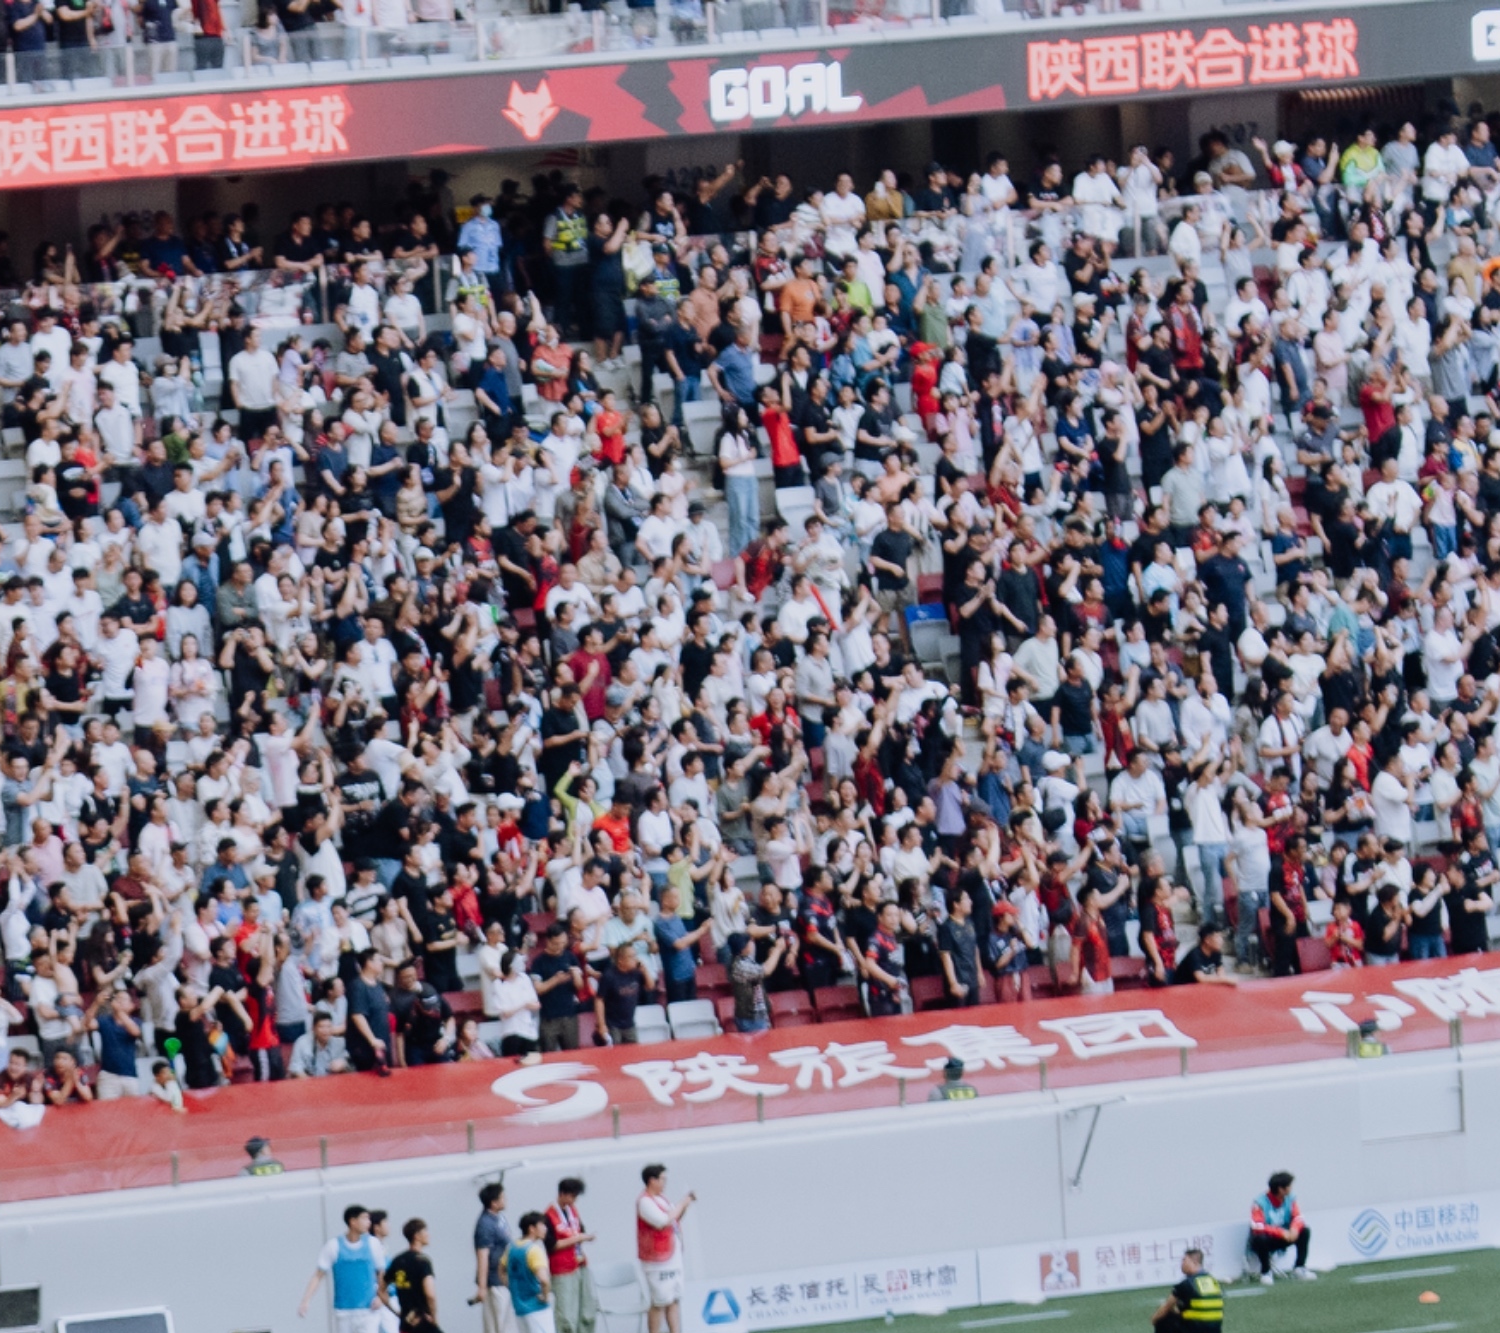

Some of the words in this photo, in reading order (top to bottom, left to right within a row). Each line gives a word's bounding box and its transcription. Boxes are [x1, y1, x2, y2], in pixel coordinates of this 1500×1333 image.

[1027, 32, 1360, 101] 陕西联合进球
[708, 61, 863, 123] GOAL
[620, 1008, 1199, 1107] 陕旅集团
[1394, 1202, 1480, 1231] 中国移动
[1396, 1234, 1434, 1249] China
[1436, 1229, 1480, 1245] Mobile
[746, 1276, 849, 1307] 长安信托
